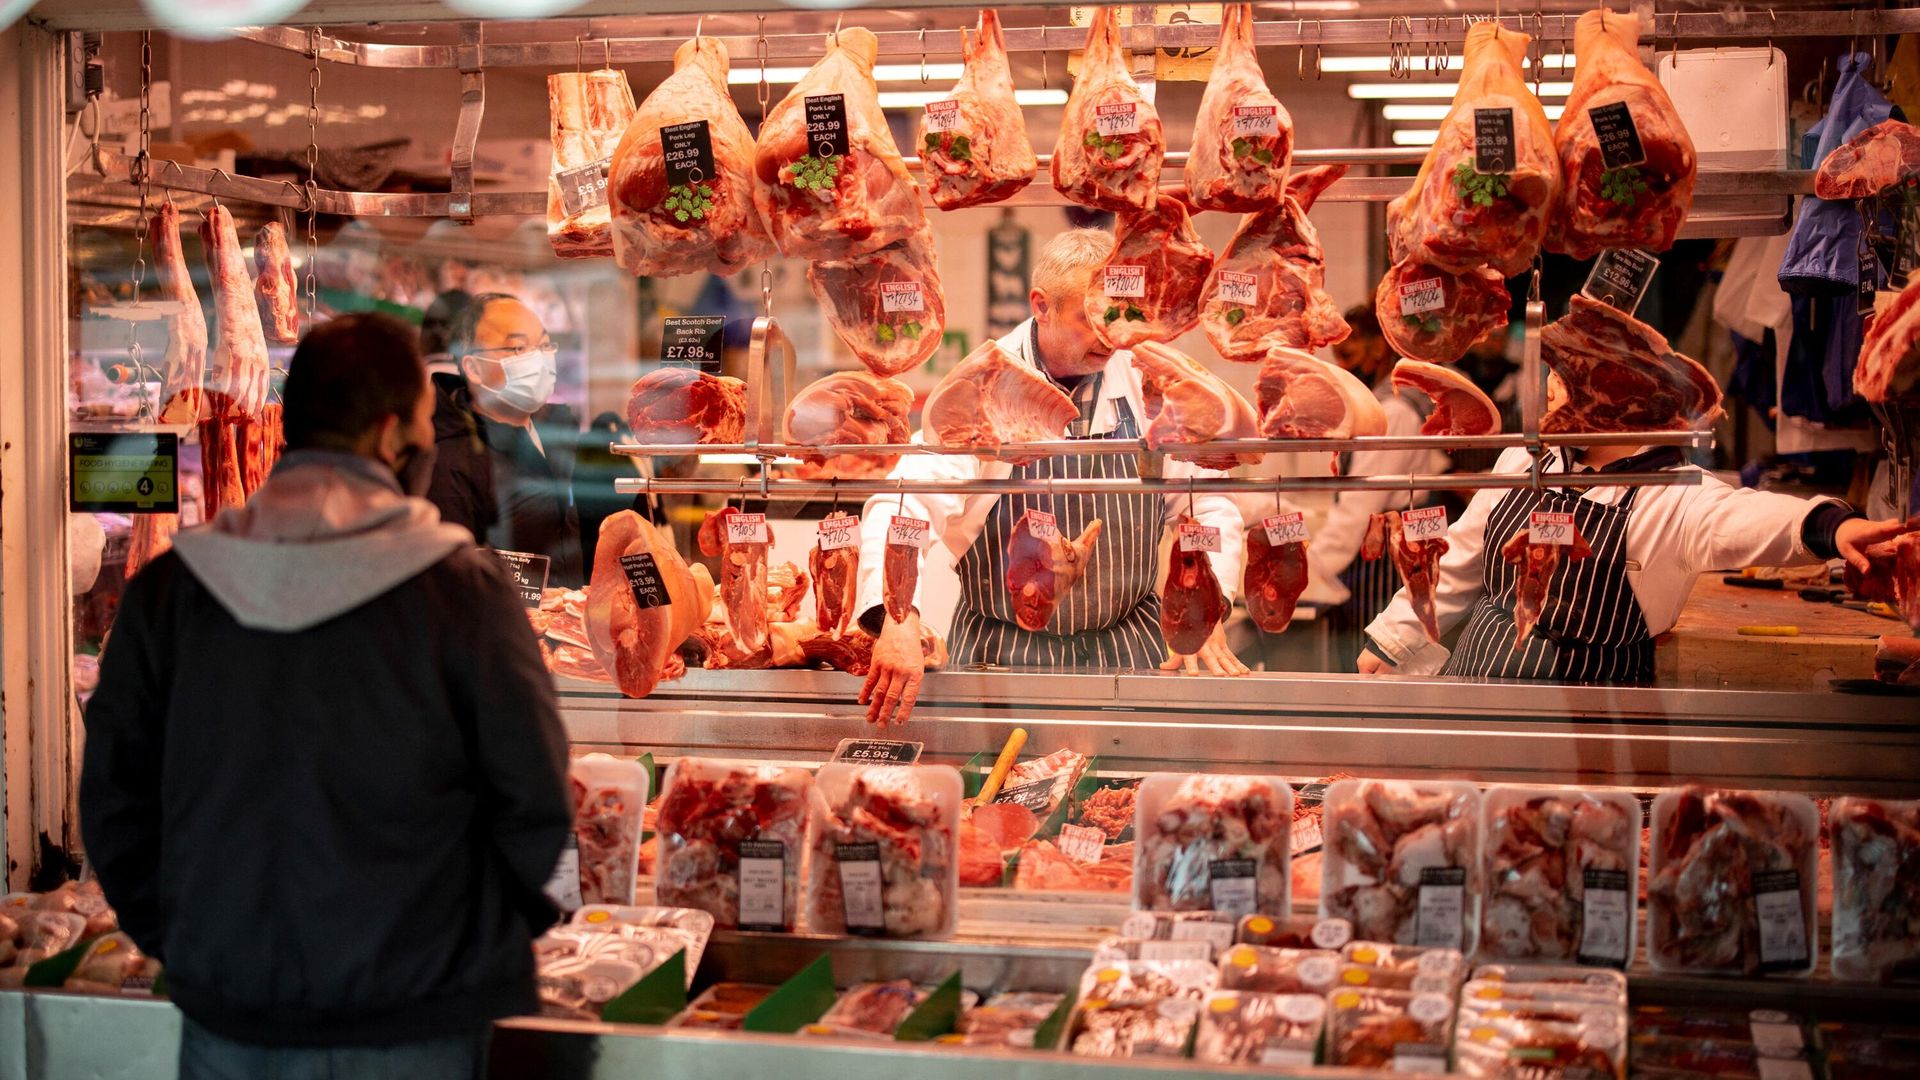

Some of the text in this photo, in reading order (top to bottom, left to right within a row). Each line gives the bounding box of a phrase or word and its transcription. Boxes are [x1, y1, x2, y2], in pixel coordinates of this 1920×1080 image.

[929, 100, 956, 113] ENGLISH
[1099, 102, 1132, 115] ENGLISH
[1238, 106, 1272, 116] ENGLISH
[679, 123, 700, 131] English
[807, 120, 840, 132] £26.99
[814, 132, 836, 142] EACH
[674, 141, 691, 149] ONLY
[1607, 142, 1630, 152] EACH
[666, 148, 700, 162] £26.99
[1482, 148, 1504, 156] EACH
[675, 160, 698, 170] EACH
[1109, 266, 1140, 276] ENGLISH
[1224, 272, 1253, 286] ENGLISH
[1604, 268, 1630, 288] £12.98
[886, 283, 916, 292] ENGLISH
[1404, 280, 1436, 295] ENGLISH
[682, 318, 705, 326] Scotch
[666, 346, 704, 358] £7.98
[140, 480, 150, 494] 4
[730, 515, 760, 524] ENGLISH
[1406, 508, 1440, 521] ENGLISH
[1536, 513, 1568, 524] ENGLISH
[822, 518, 855, 531] ENGLISH
[894, 516, 928, 530] ENGLISH
[1268, 513, 1299, 528] ENGLISH
[1183, 525, 1217, 536] ENGLISH
[520, 577, 530, 586] kg
[630, 576, 656, 588] £13.99
[640, 586, 658, 594] EACH
[852, 750, 890, 759] £5.98
